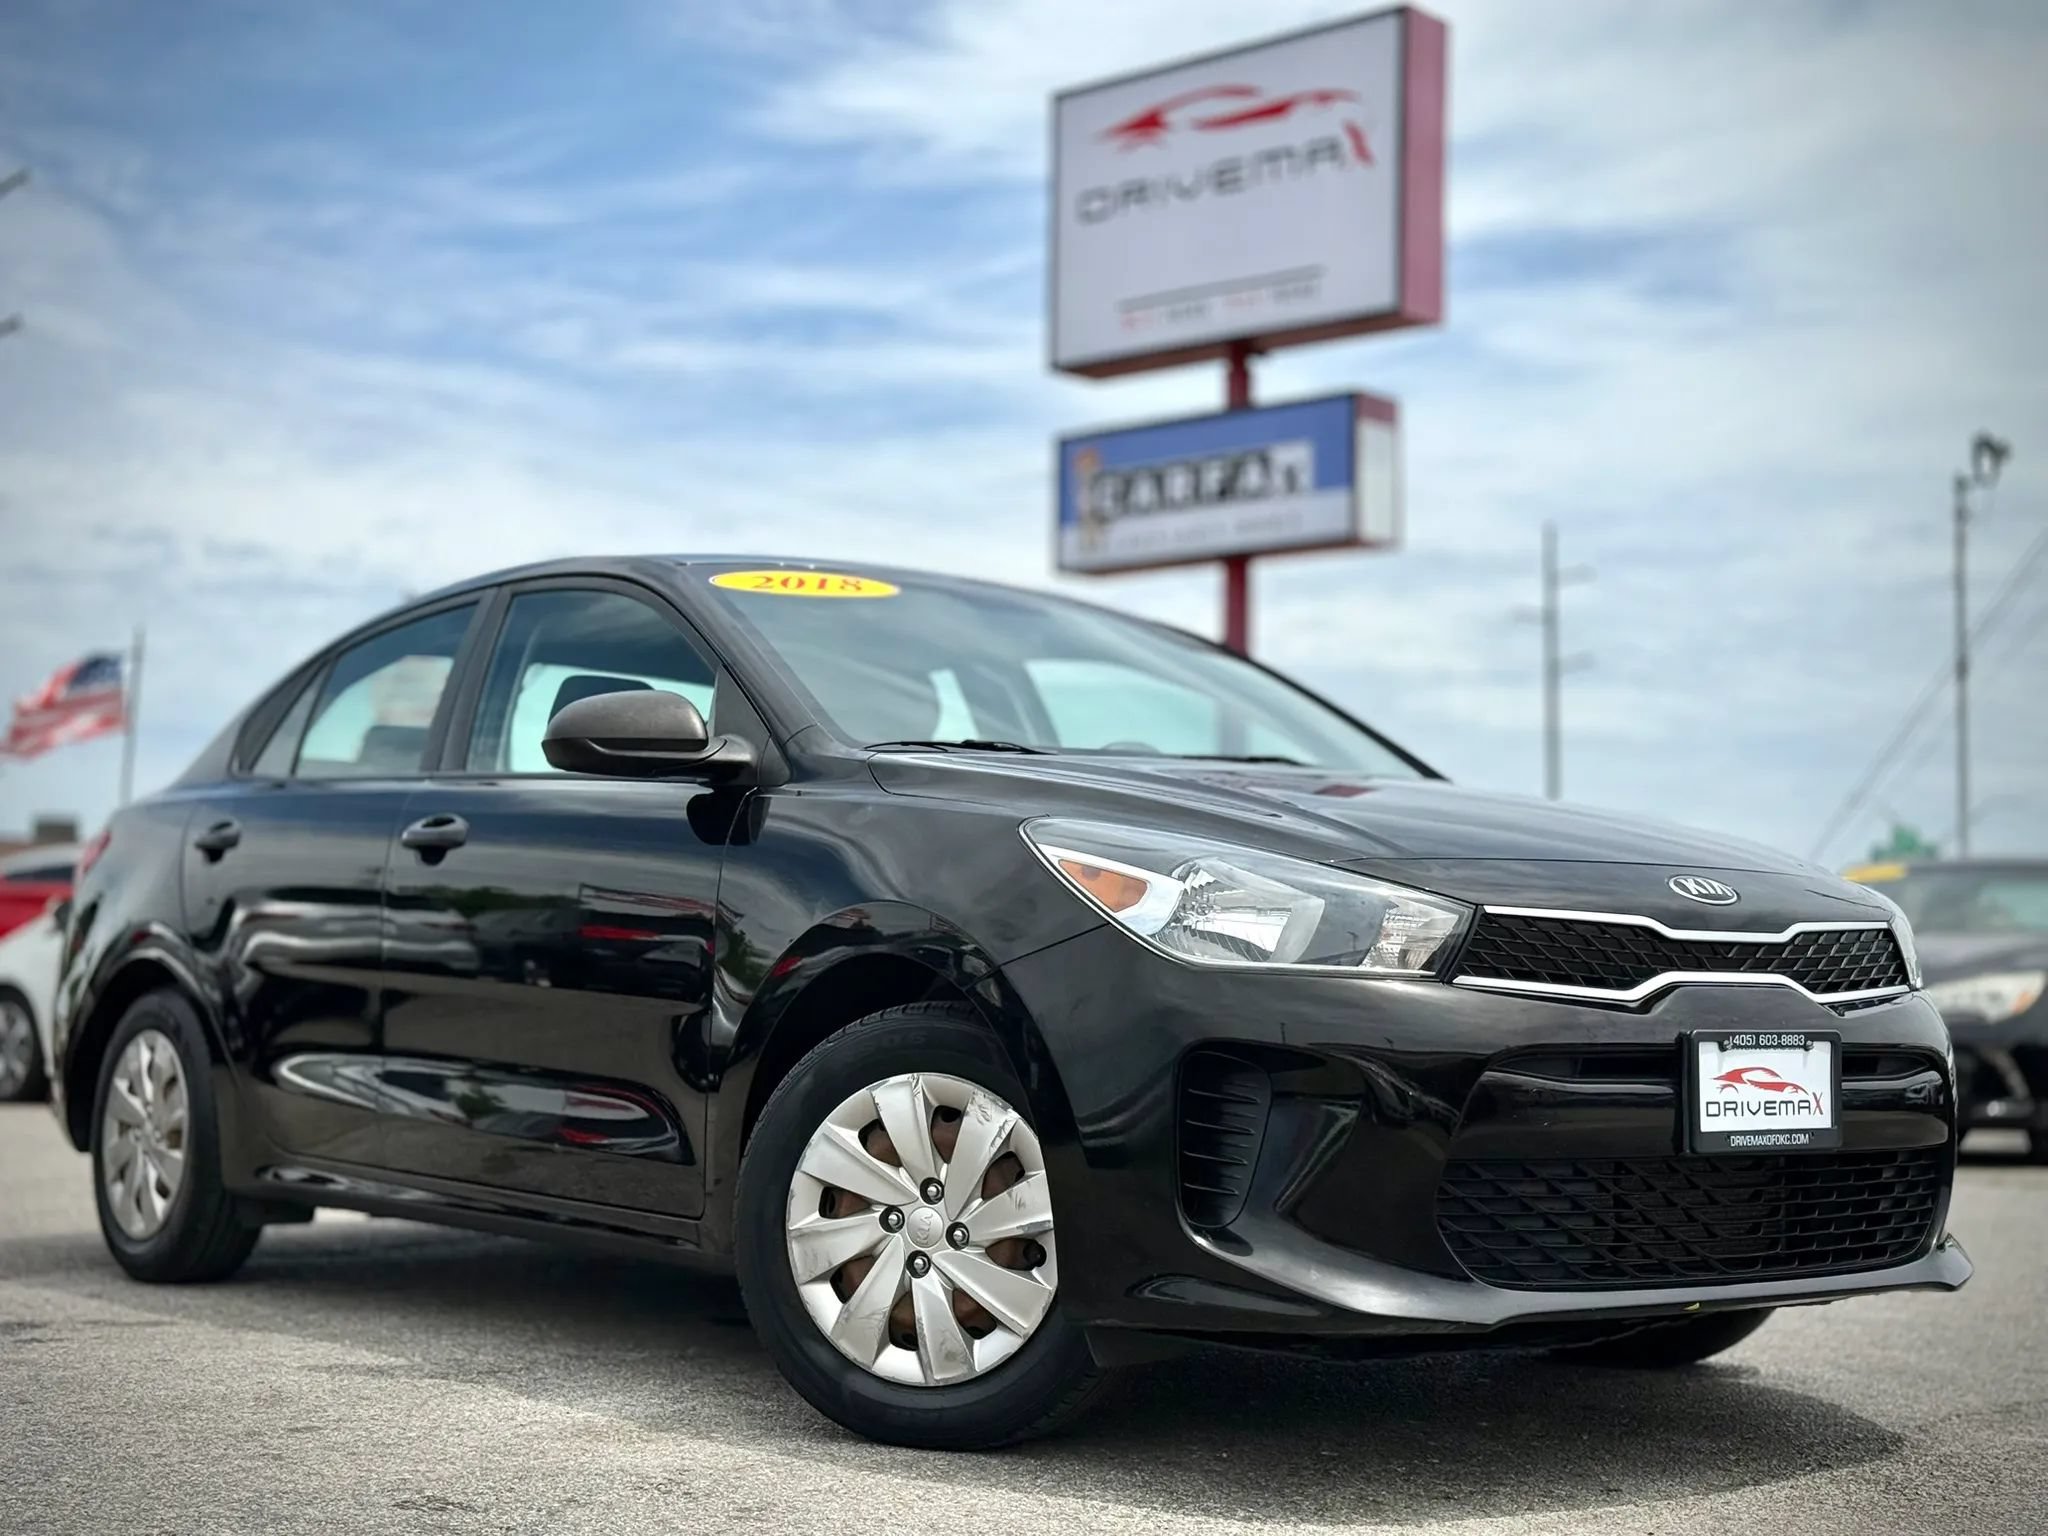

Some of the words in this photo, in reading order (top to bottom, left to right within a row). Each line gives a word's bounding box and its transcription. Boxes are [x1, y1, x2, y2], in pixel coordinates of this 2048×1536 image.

[752, 576, 862, 591] 2018
[1676, 878, 1733, 896] KIA
[1729, 1034, 1756, 1046] (405)
[1758, 1034, 1805, 1046] 603-8883
[1706, 1092, 1823, 1117] DRIVEMAX
[1730, 1133, 1809, 1147] DRIVEMAXOFOKC.COM
